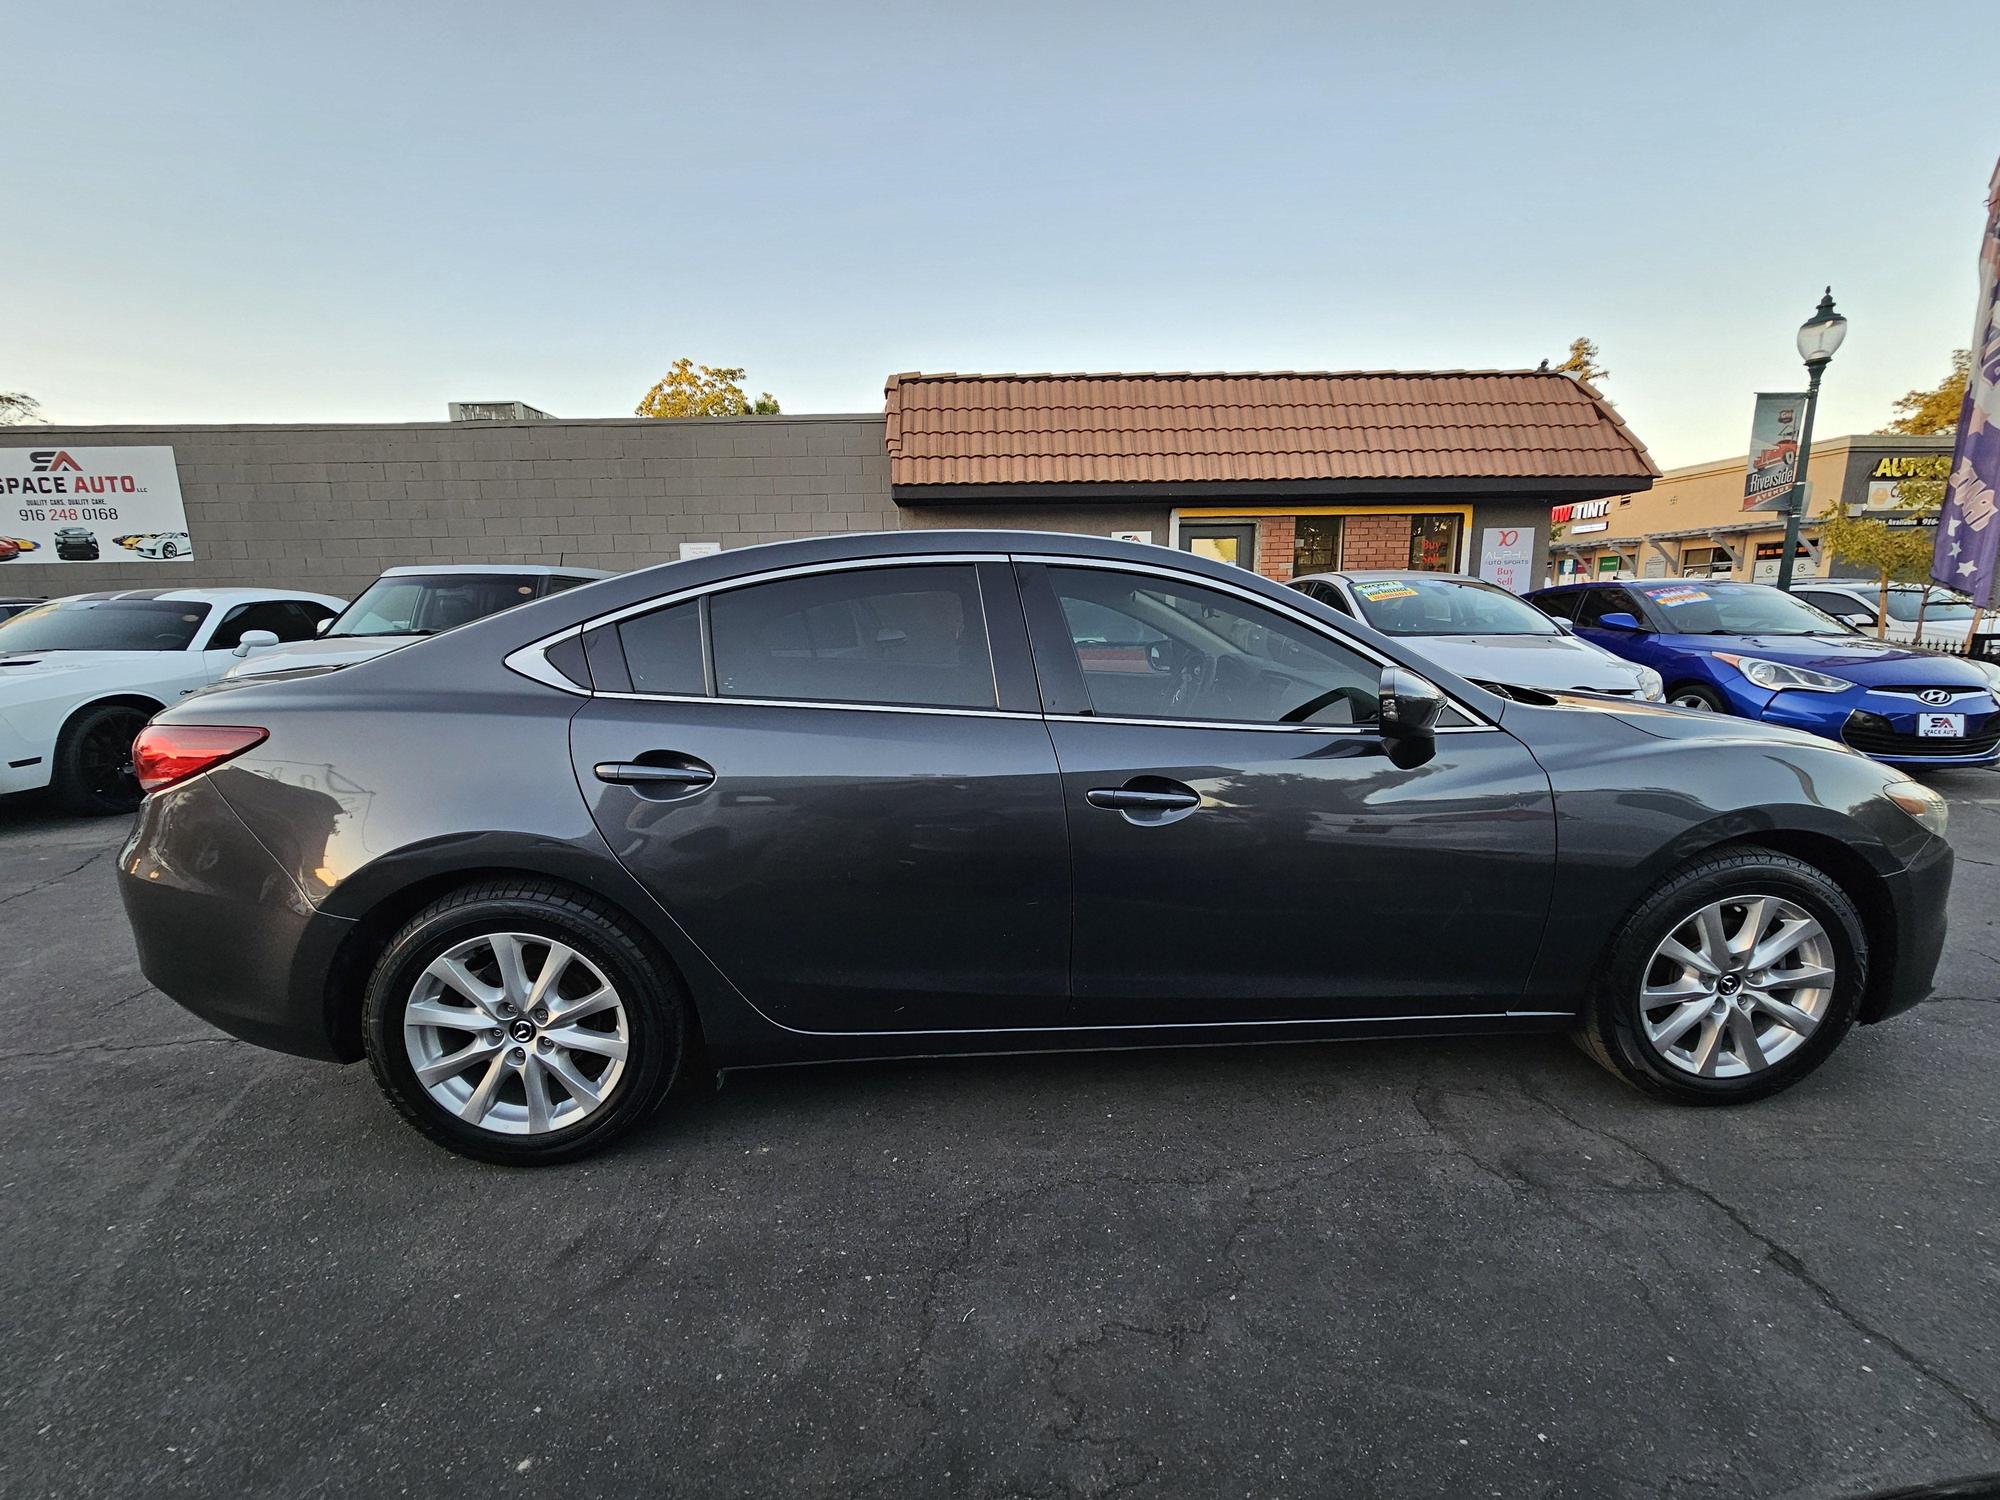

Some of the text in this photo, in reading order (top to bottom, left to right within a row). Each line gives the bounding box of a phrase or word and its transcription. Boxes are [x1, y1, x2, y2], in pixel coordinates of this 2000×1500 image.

[74, 475, 136, 493] AUTO
[1750, 467, 1793, 493] Riverside
[1755, 485, 1791, 503] AVENUE
[68, 498, 89, 506] QUALITY
[19, 508, 119, 521] 916 248 0168
[1577, 501, 1608, 519] TINT
[1422, 539, 1441, 553] Buy
[1497, 567, 1513, 578] Buy
[1496, 577, 1513, 586] Sell
